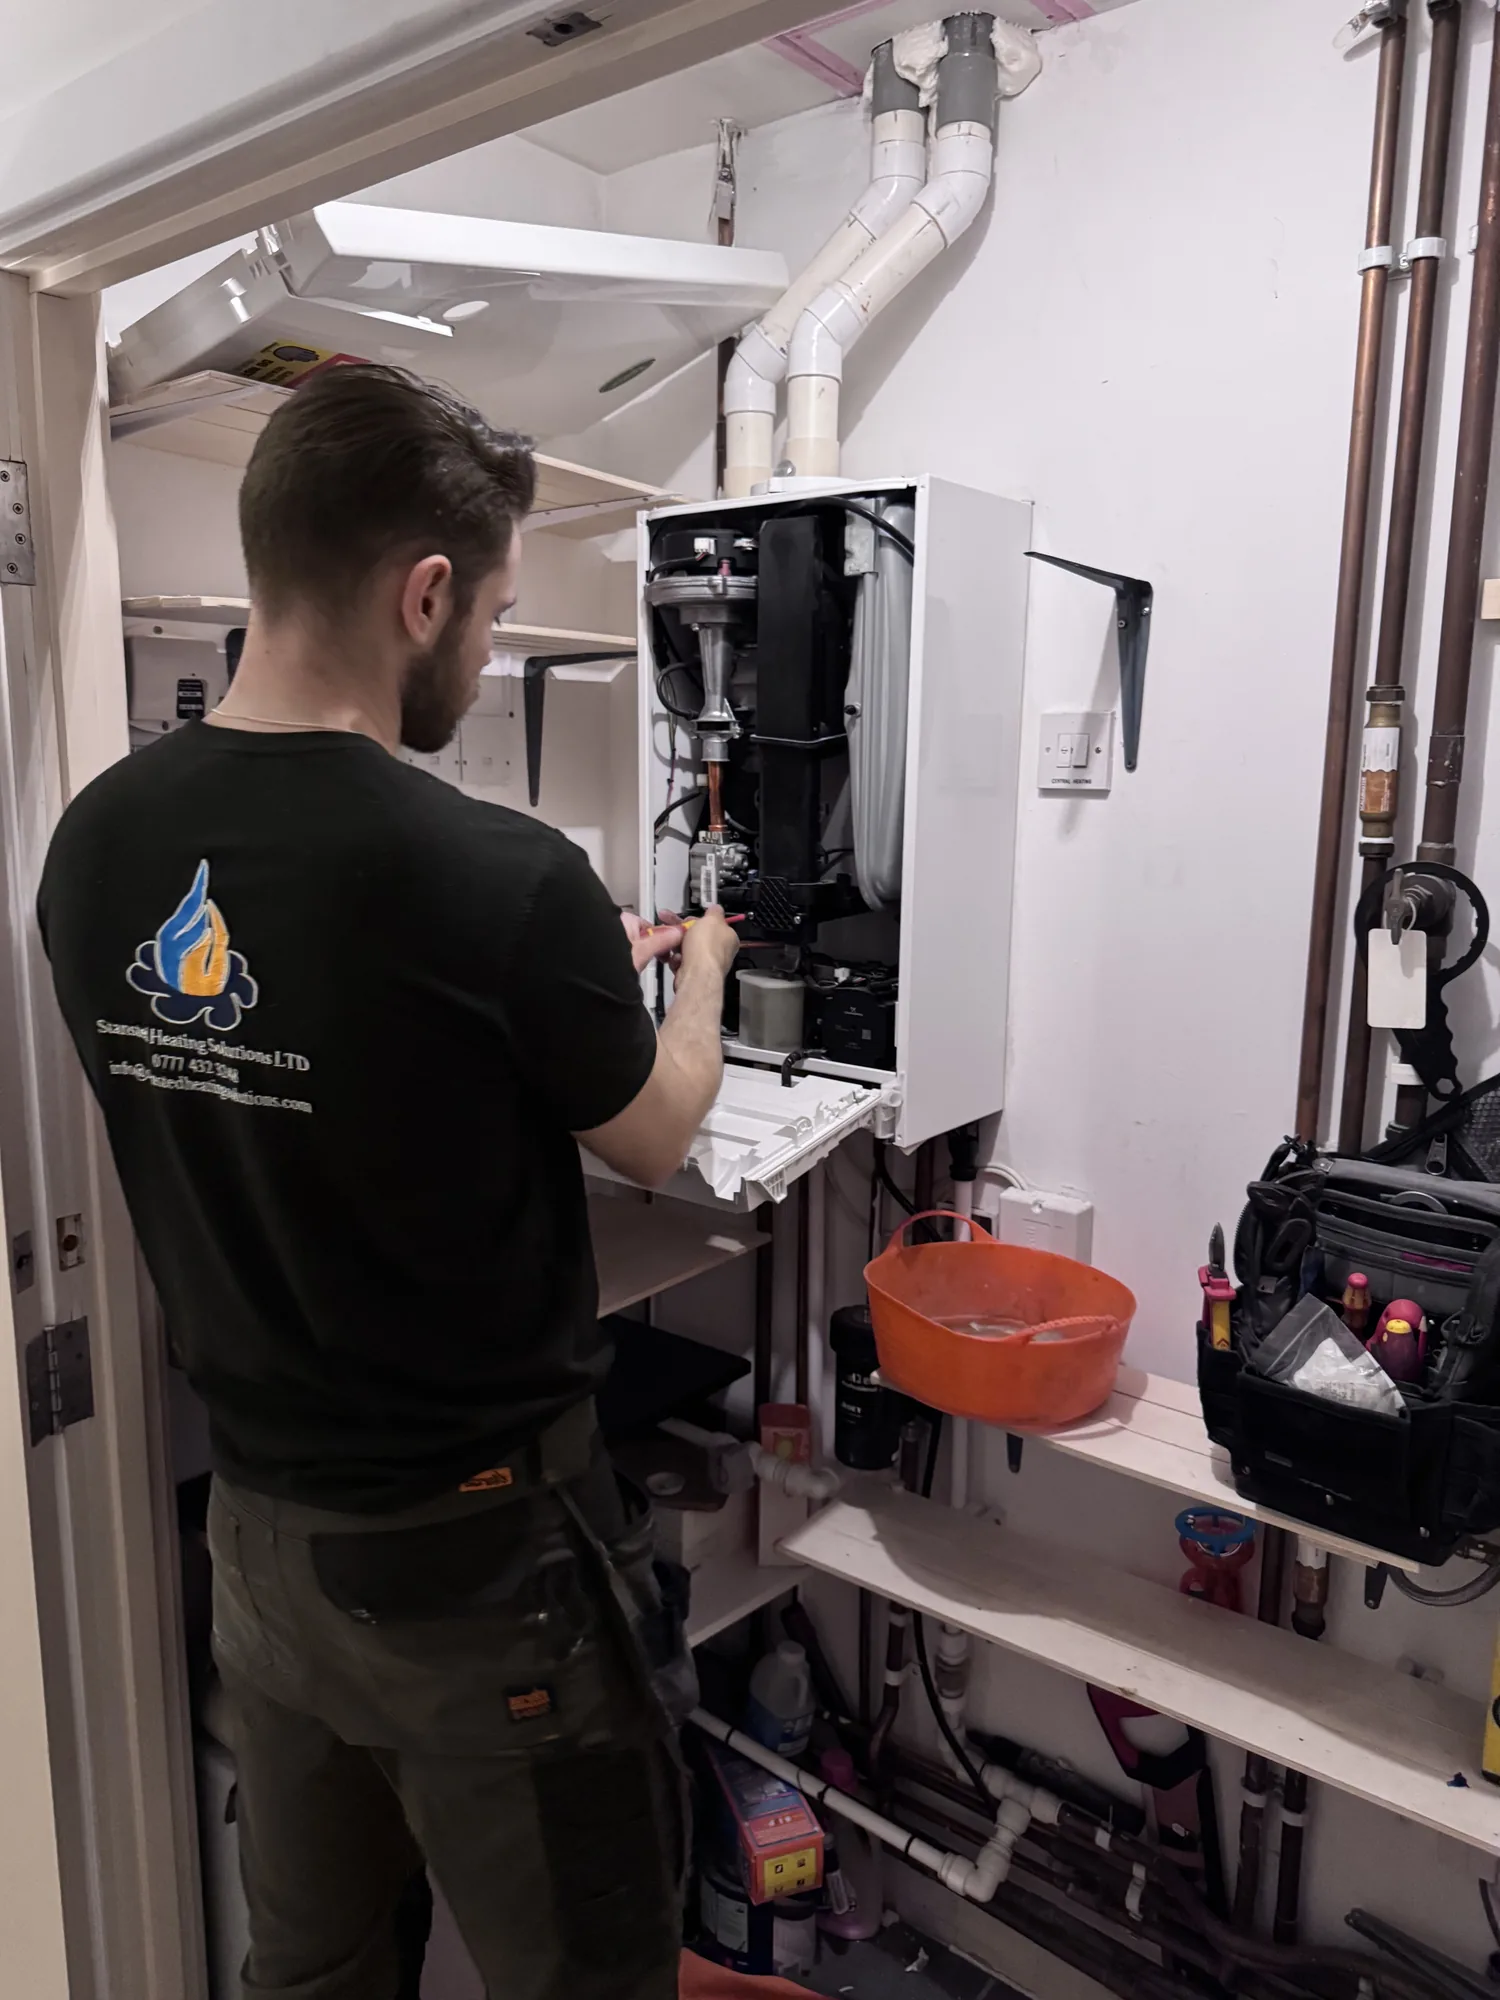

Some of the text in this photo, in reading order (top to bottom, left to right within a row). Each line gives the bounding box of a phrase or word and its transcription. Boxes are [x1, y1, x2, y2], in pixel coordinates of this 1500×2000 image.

[149, 1028, 209, 1055] Heating
[207, 1037, 273, 1065] Solutions
[273, 1050, 311, 1072] LTD
[188, 1058, 215, 1074] 432
